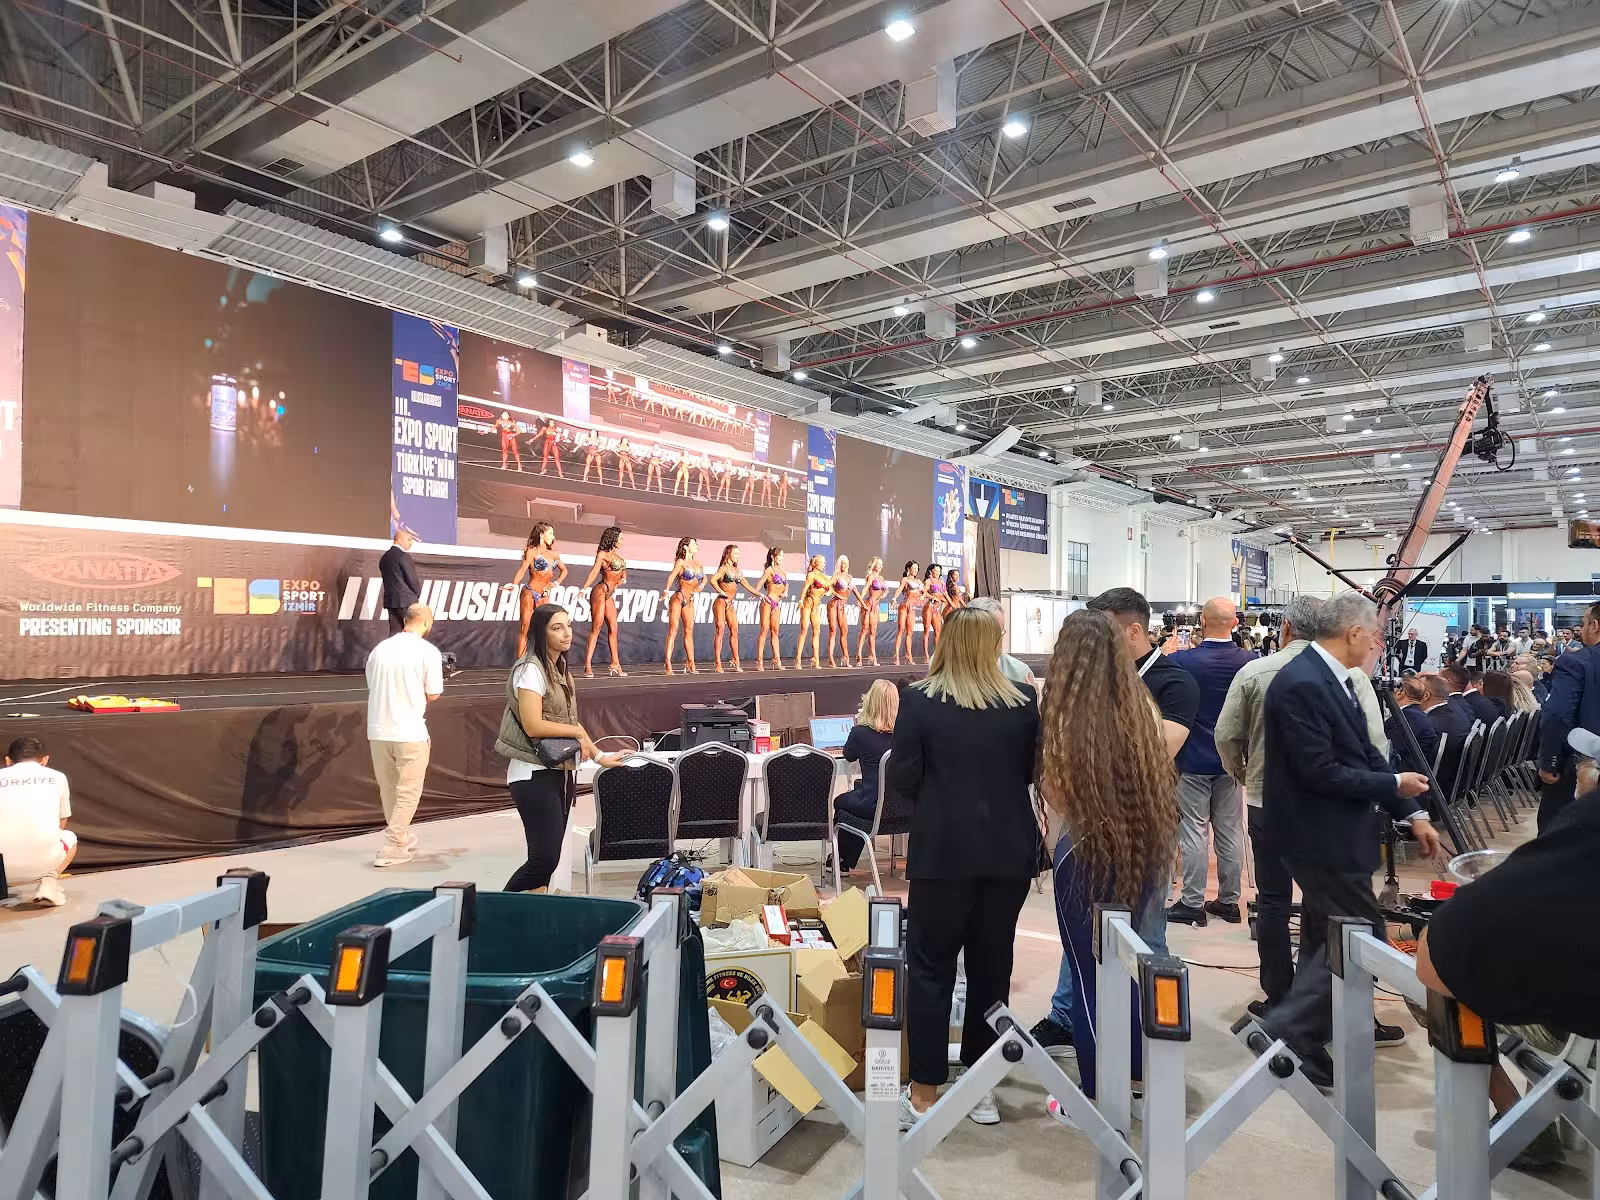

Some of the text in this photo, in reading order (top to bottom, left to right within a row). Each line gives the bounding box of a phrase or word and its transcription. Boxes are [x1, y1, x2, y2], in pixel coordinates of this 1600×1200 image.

[435, 367, 454, 377] EXPO
[435, 374, 457, 384] SPORT
[394, 416, 458, 454] EXPO SPORT
[396, 448, 455, 480] TÜRKİYE'NİN
[402, 476, 424, 496] SPOR
[282, 579, 321, 591] EXPO
[282, 590, 326, 601] SPORT
[19, 602, 182, 614] Worldwide Fitness Company
[283, 600, 317, 611] İZMİR
[19, 617, 182, 636] PRESENTING SPONSOR
[0, 776, 56, 788] ÜRKİYE
